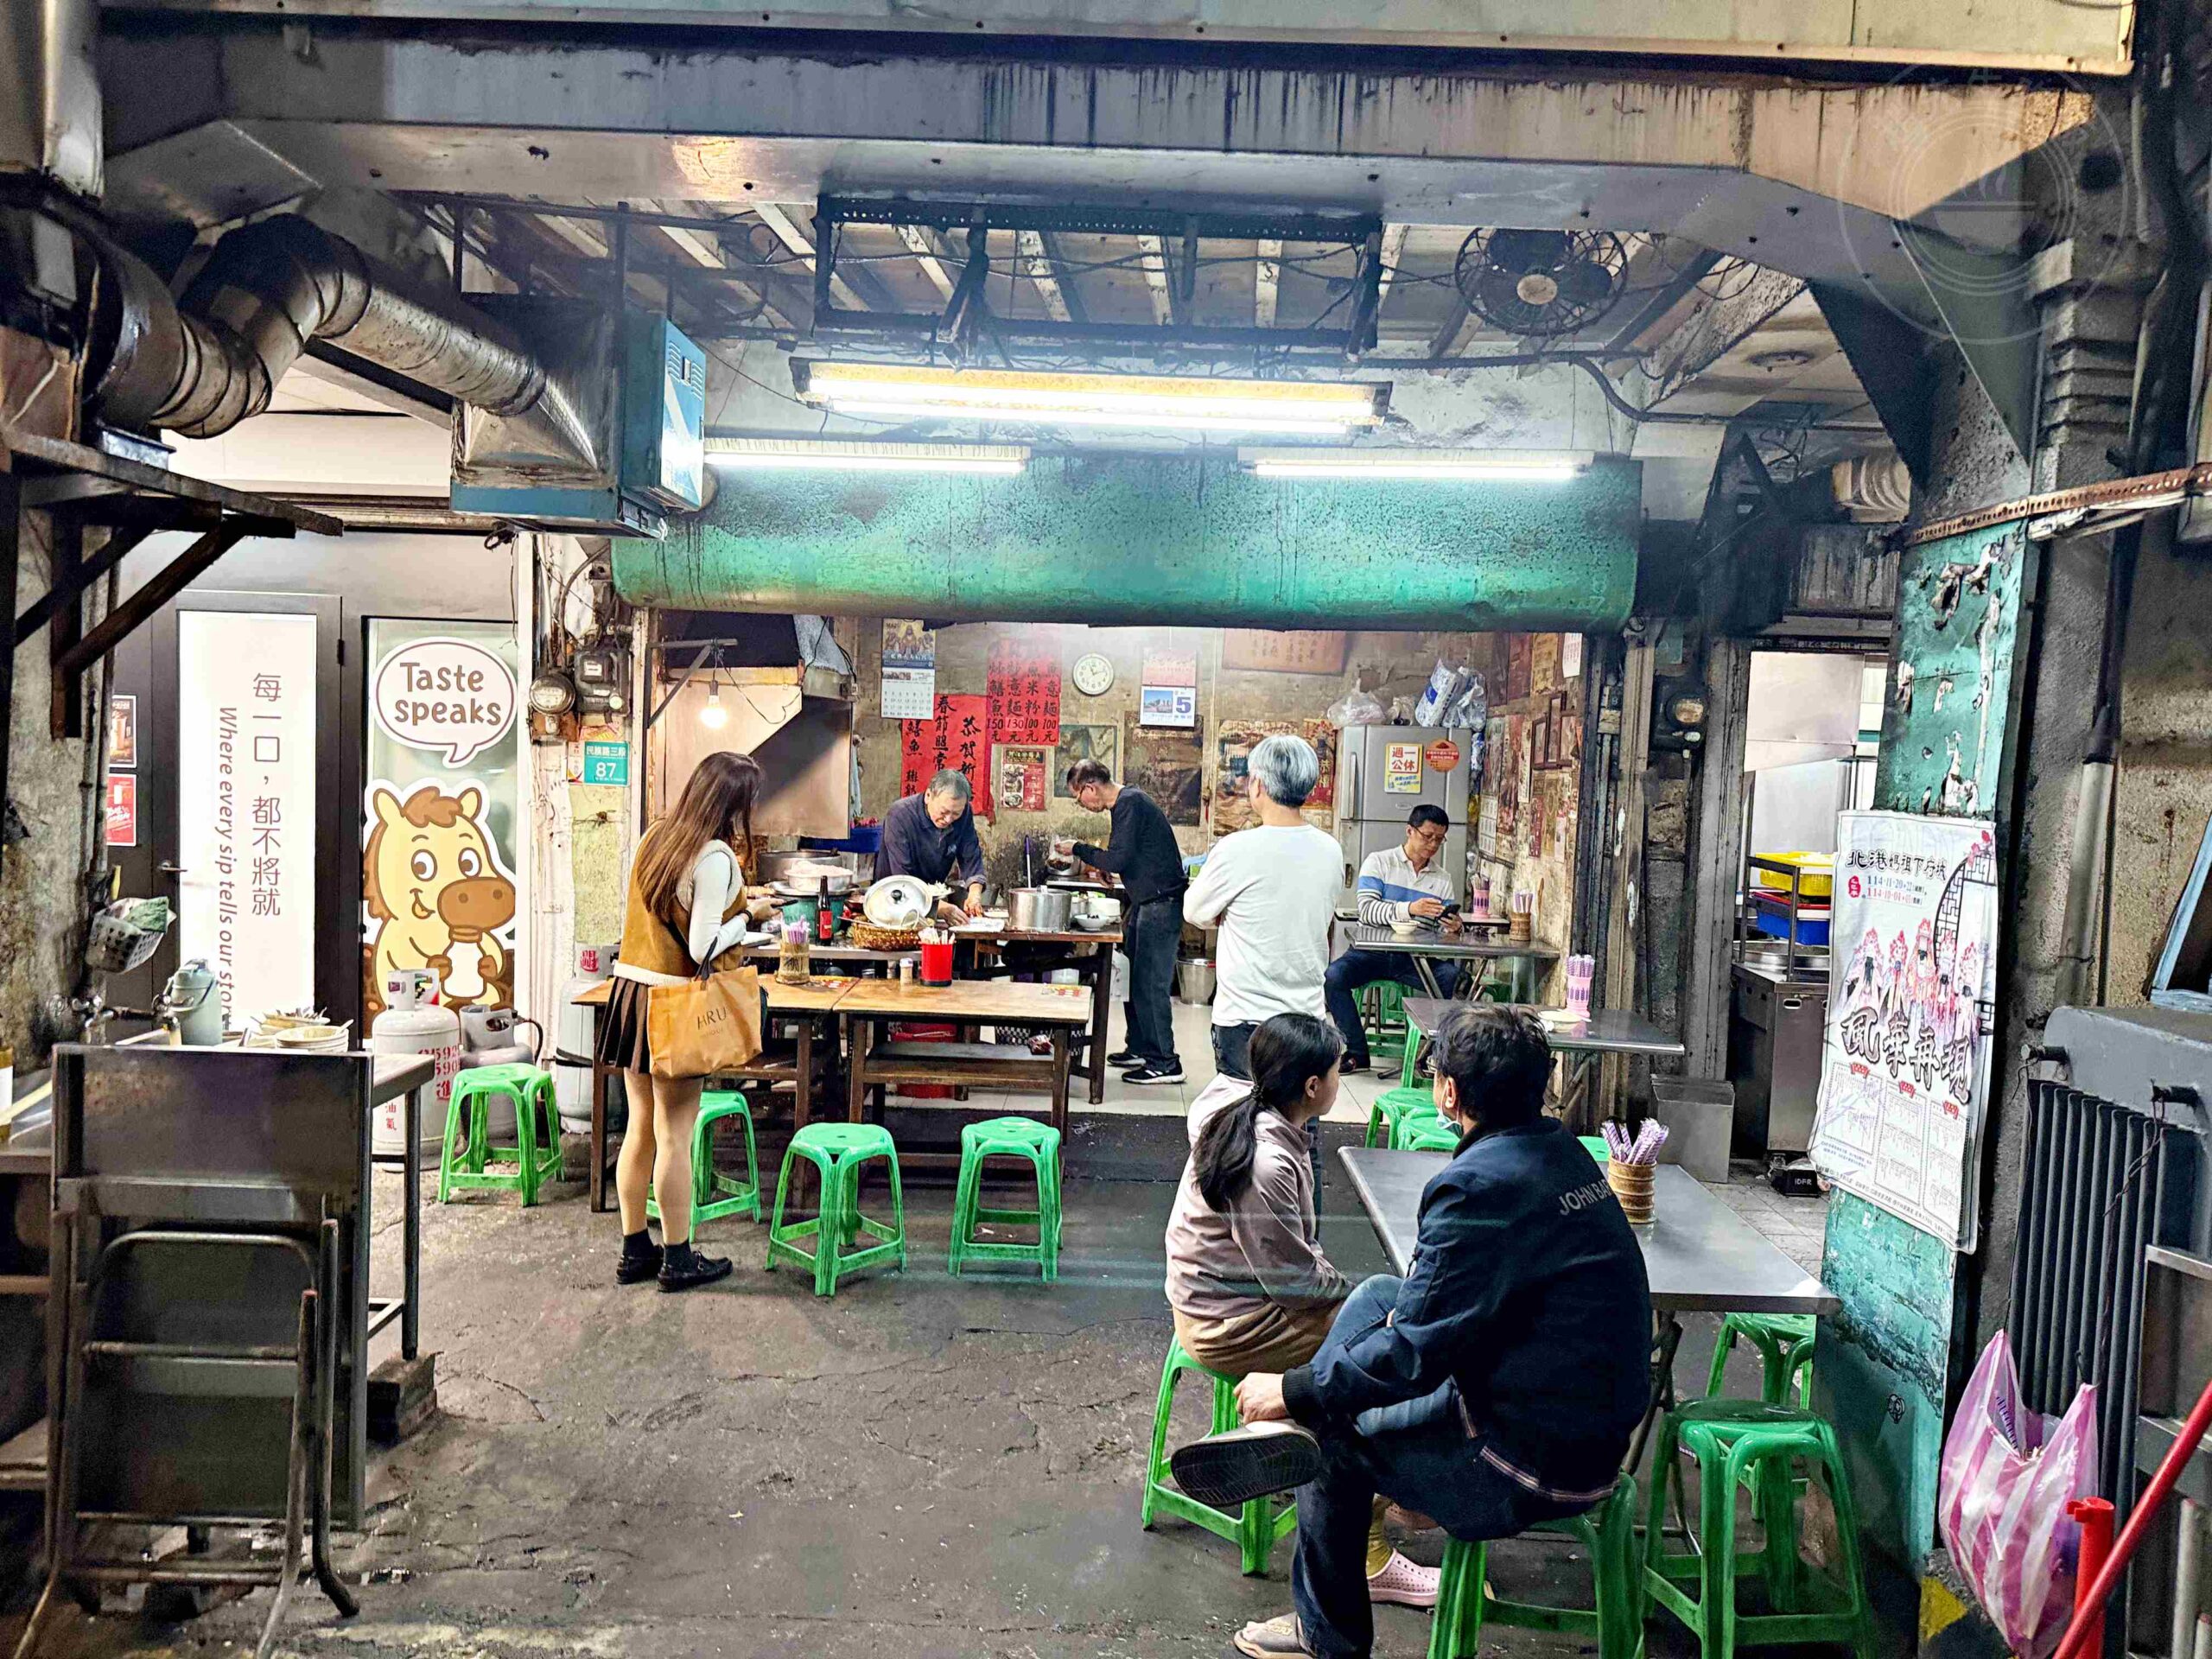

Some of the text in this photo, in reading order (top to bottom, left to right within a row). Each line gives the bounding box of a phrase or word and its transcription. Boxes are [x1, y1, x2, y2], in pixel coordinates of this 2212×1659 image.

[400, 662, 484, 692] Taste
[394, 698, 501, 726] speaks
[1176, 697, 1192, 714] 5
[219, 707, 238, 774] Where
[1392, 747, 1416, 759] 週一
[595, 761, 617, 778] 87
[959, 715, 982, 801] 恭賀新
[1391, 760, 1415, 771] 公休
[252, 672, 282, 916] 每一口，都不將就
[214, 779, 233, 840] every
[214, 844, 238, 874] sip
[219, 880, 238, 925] tells
[219, 929, 232, 967] our
[1559, 1185, 1598, 1216] JOHN
